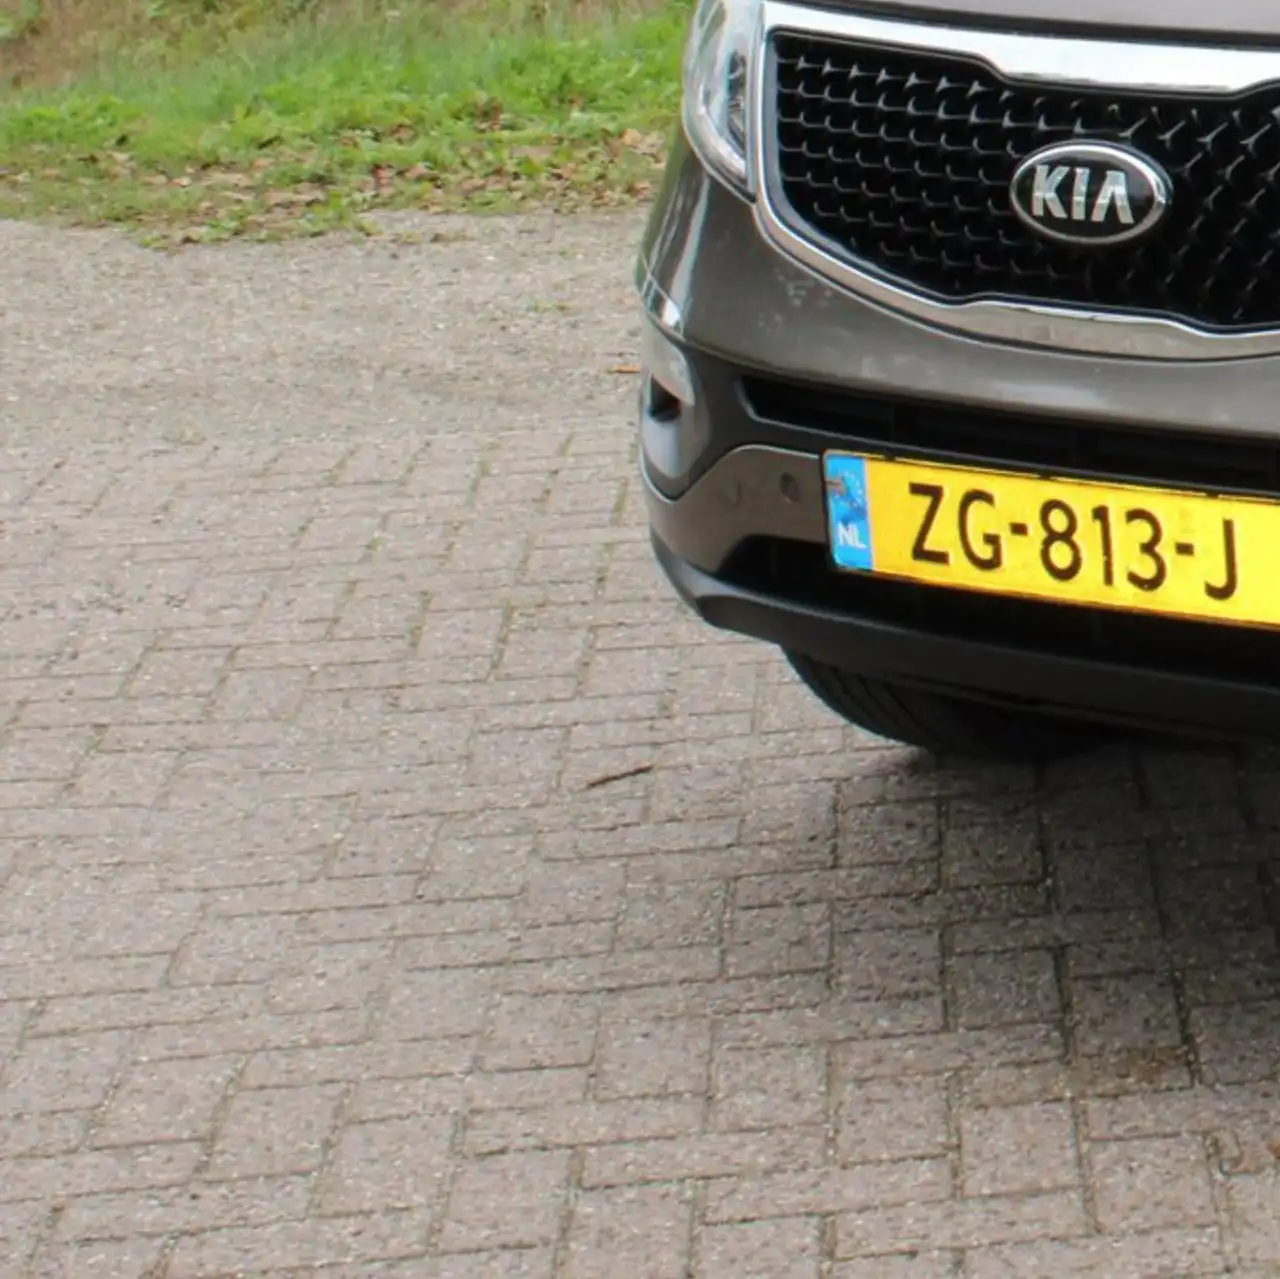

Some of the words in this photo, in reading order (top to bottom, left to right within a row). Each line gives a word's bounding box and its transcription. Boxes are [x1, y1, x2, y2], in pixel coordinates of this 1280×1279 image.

[1031, 163, 1135, 224] KIA
[837, 522, 867, 549] NL
[908, 482, 1240, 601] ZG-813-J
